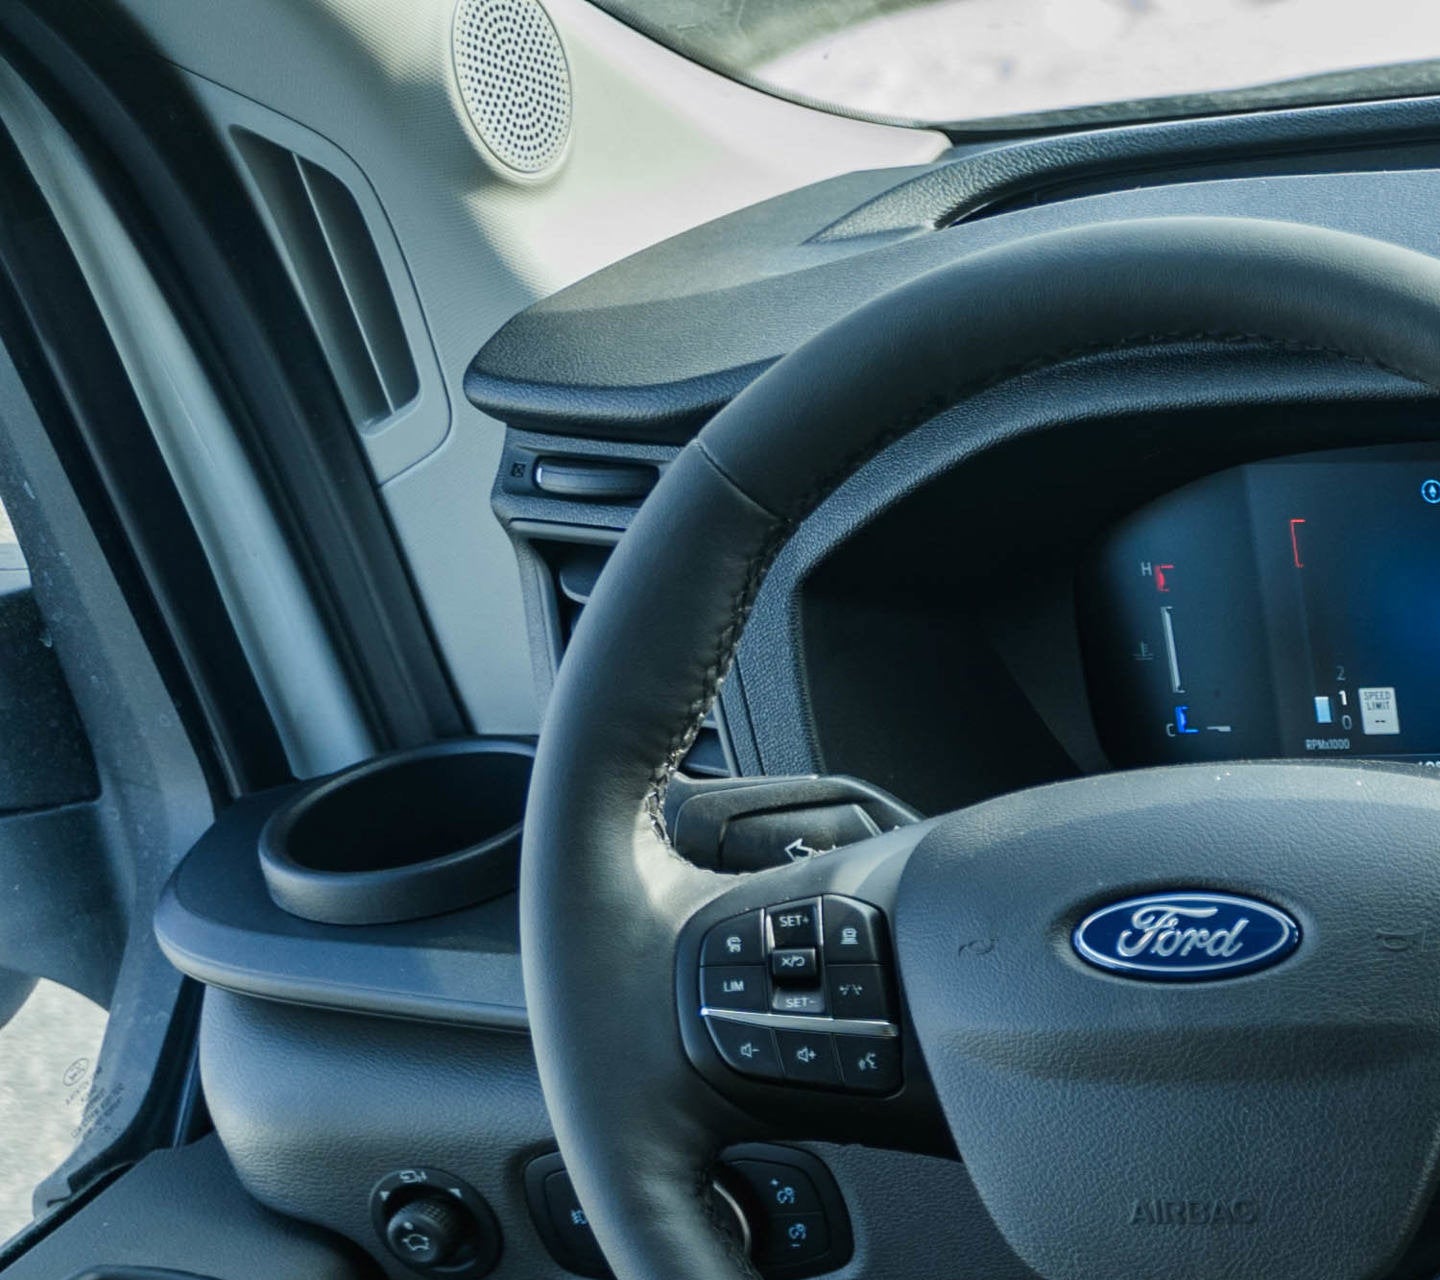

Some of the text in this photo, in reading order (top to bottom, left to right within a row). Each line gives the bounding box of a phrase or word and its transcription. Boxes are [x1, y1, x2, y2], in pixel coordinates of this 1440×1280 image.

[1141, 561, 1152, 576] H
[1336, 666, 1347, 681] 2
[1338, 690, 1348, 705] 1
[1363, 691, 1391, 701] SPEED
[1365, 701, 1391, 712] LIMIT
[1341, 715, 1352, 730] 0
[1166, 724, 1176, 737] C
[1115, 904, 1250, 958] Ford
[723, 980, 745, 993] LIM
[1128, 1199, 1258, 1225] AIRBAG
